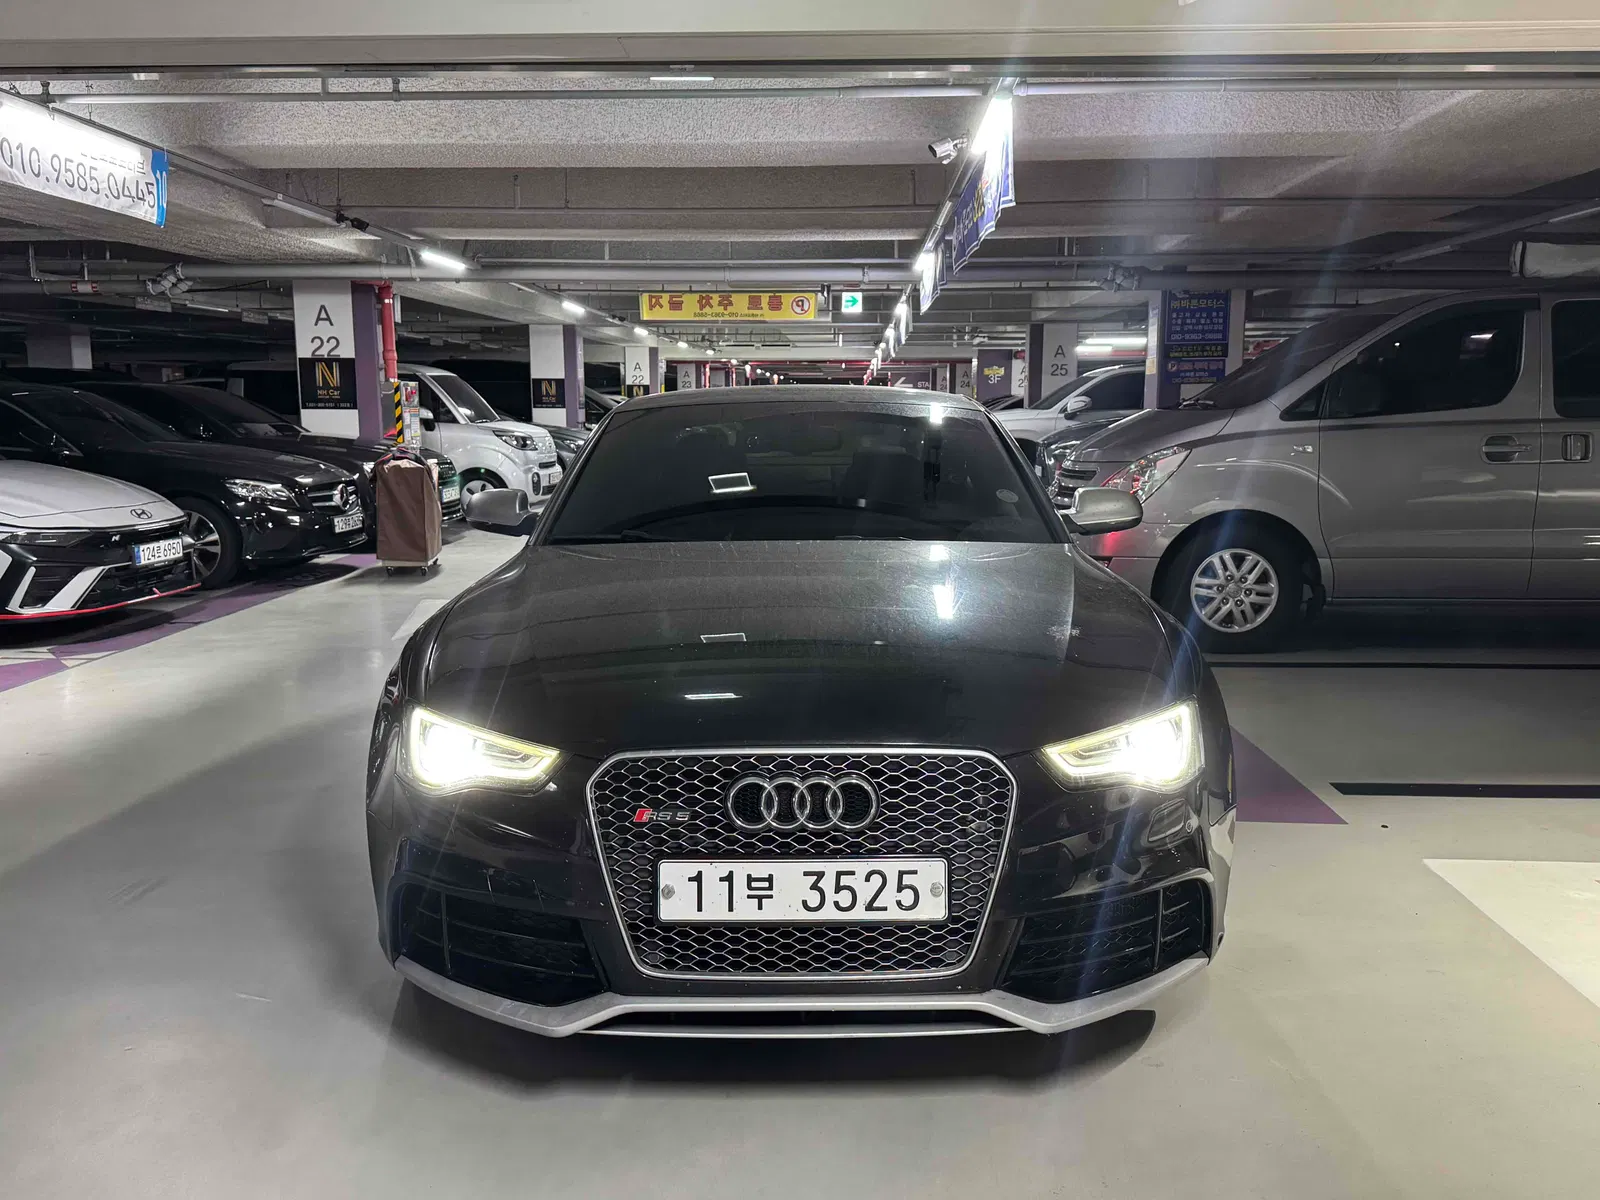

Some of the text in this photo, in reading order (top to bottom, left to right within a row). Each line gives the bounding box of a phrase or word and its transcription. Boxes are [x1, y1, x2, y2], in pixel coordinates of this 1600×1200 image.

[0, 136, 156, 209] 010.9585.0445
[314, 304, 334, 327] A
[310, 336, 341, 358] 22
[1053, 345, 1066, 358] A
[633, 362, 643, 372] A
[1050, 363, 1068, 376] 25
[632, 375, 644, 384] 22
[681, 381, 692, 389] 23
[961, 380, 970, 389] 24
[988, 374, 1001, 384] 3F
[687, 869, 920, 913] 11부 3525
